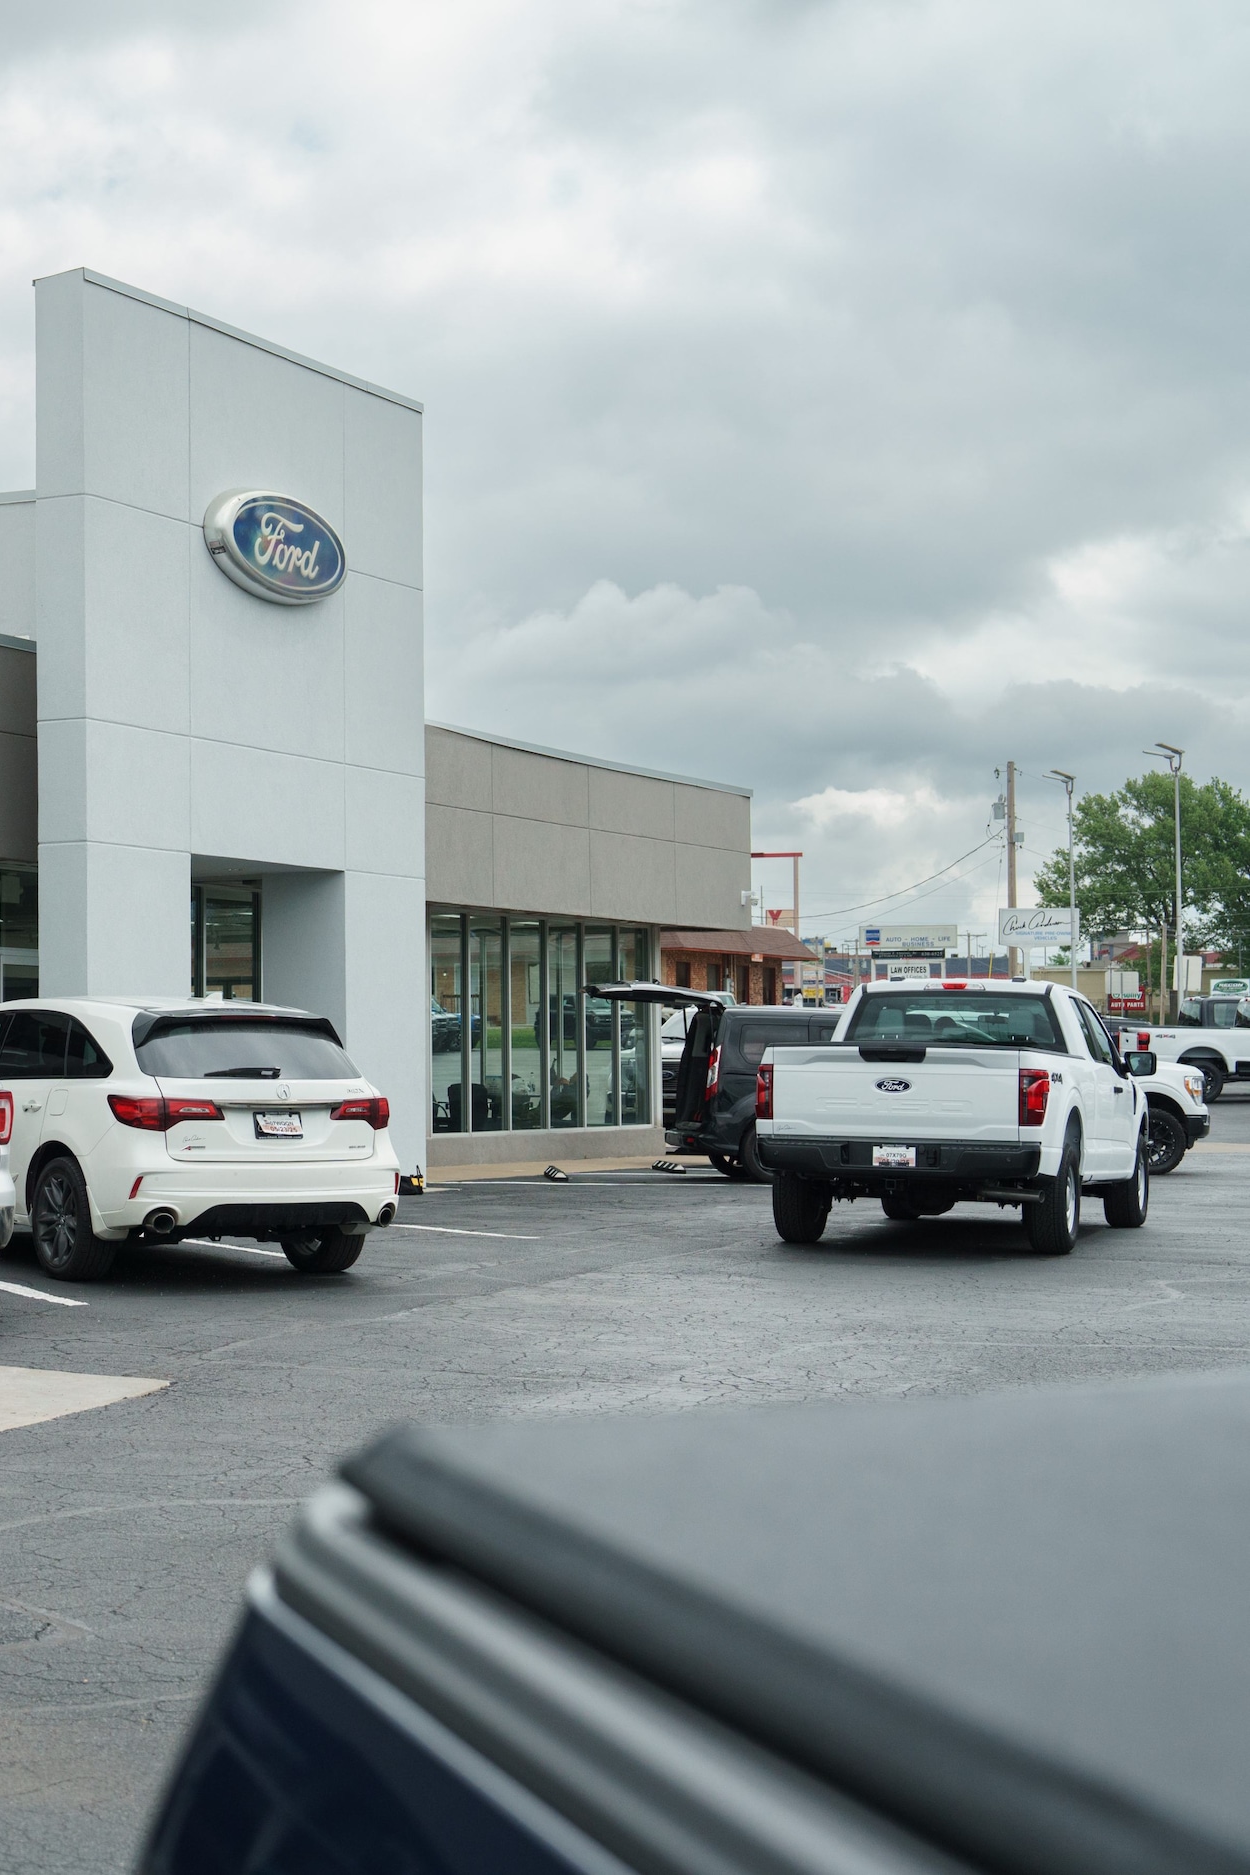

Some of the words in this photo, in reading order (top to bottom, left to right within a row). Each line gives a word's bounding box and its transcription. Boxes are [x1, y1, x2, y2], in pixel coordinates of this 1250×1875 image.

[254, 511, 320, 580] Ford
[1003, 914, 1026, 936] Chuck
[1028, 910, 1072, 931] Anderson
[890, 966, 902, 974] LAW
[903, 966, 927, 974] OFFICES
[881, 1080, 905, 1091] Ford
